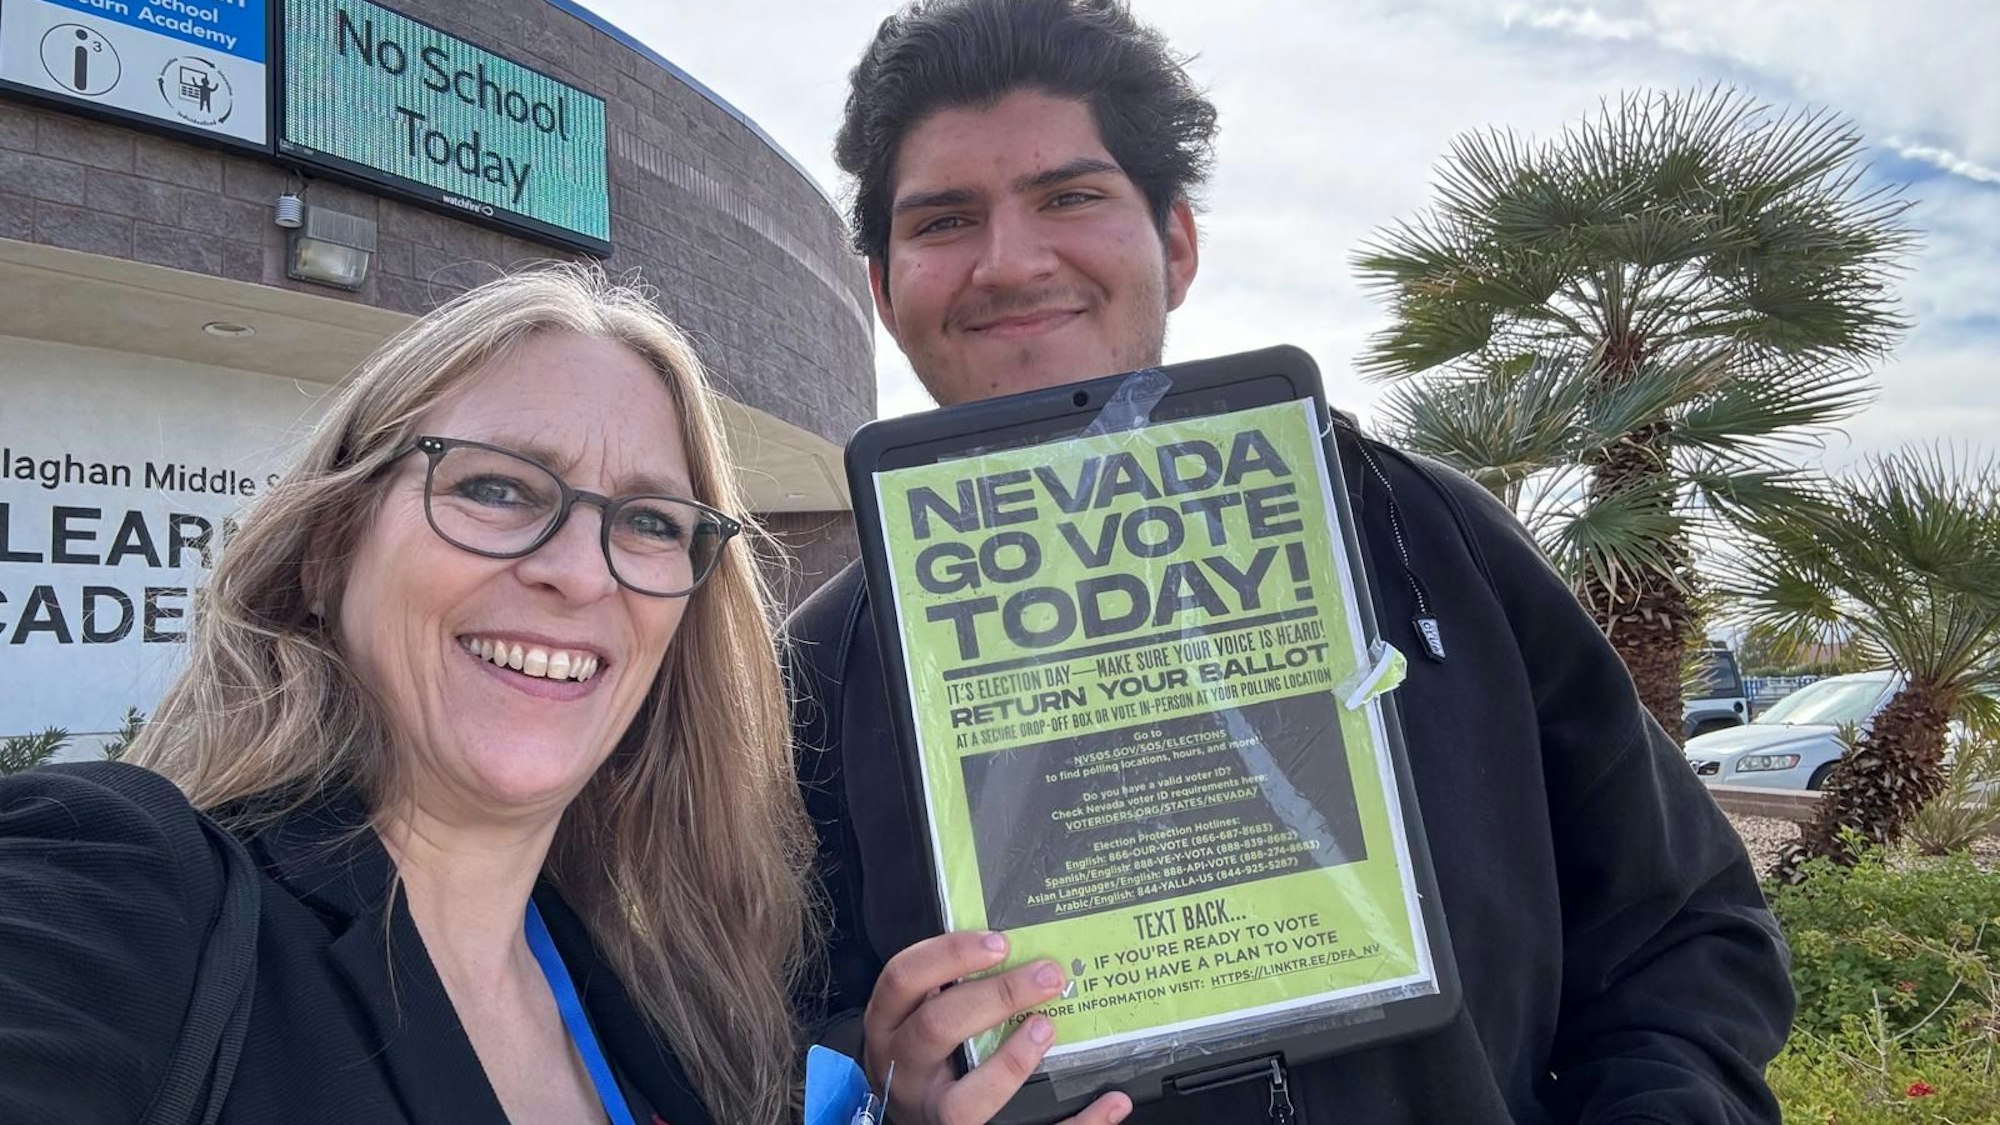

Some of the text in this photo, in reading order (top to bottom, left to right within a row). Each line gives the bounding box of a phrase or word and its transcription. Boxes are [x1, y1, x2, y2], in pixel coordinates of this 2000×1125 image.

[79, 0, 238, 49] arn Academy
[337, 9, 568, 142] No School
[395, 105, 531, 204] Today
[3, 448, 131, 489] laghan
[145, 462, 256, 496] Middle
[907, 429, 1292, 540] NEVADA
[915, 482, 1304, 594] GO VOTE
[0, 585, 206, 644] ADE
[926, 541, 1314, 661] TODAY!
[947, 682, 975, 706] IT'S
[978, 671, 1042, 700] ELECTION
[1137, 647, 1171, 671] SURE
[1173, 638, 1211, 665] YOUR
[1214, 632, 1256, 657] VOICE
[1259, 628, 1273, 649] IS
[1276, 620, 1326, 647] HEARD!
[950, 643, 1329, 729] RETURN YOUR BALLOT
[956, 667, 1332, 749] AT A SECURE DROP-OFF BOX OR VOTE IN-PERSON AT YOUR POLLING LOCATION
[1045, 736, 1260, 783] to find polling locations, hours, and more!
[1133, 730, 1162, 741] Go to
[1051, 774, 1268, 820] Check Nevada voter ID requirements here:
[1083, 766, 1231, 802] Do you have a valid voter ID?
[1065, 855, 1107, 871] English:
[1109, 838, 1189, 862] 866-OUR-VOTE
[1093, 817, 1241, 851] Election Protection Hotlines:
[1027, 892, 1057, 905] Asian
[1059, 871, 1161, 899] Languages/English:
[1163, 855, 1238, 877] 888-API-VOTE
[1045, 863, 1132, 888] Spanish/English:
[1134, 847, 1214, 870] 888-VE-Y-VOTA
[1055, 890, 1135, 913] Arabic/English:
[1137, 873, 1214, 897] 844-YALLA-US
[1094, 913, 1320, 970] IF YOU'RE READY TO VOTE
[1133, 898, 1246, 940] TEXT BACK...
[1083, 930, 1338, 992] IF YOU HAVE A PLAN TO VOTE
[1078, 987, 1166, 1013] INFORMATION
[1169, 978, 1205, 995] VISIT:
